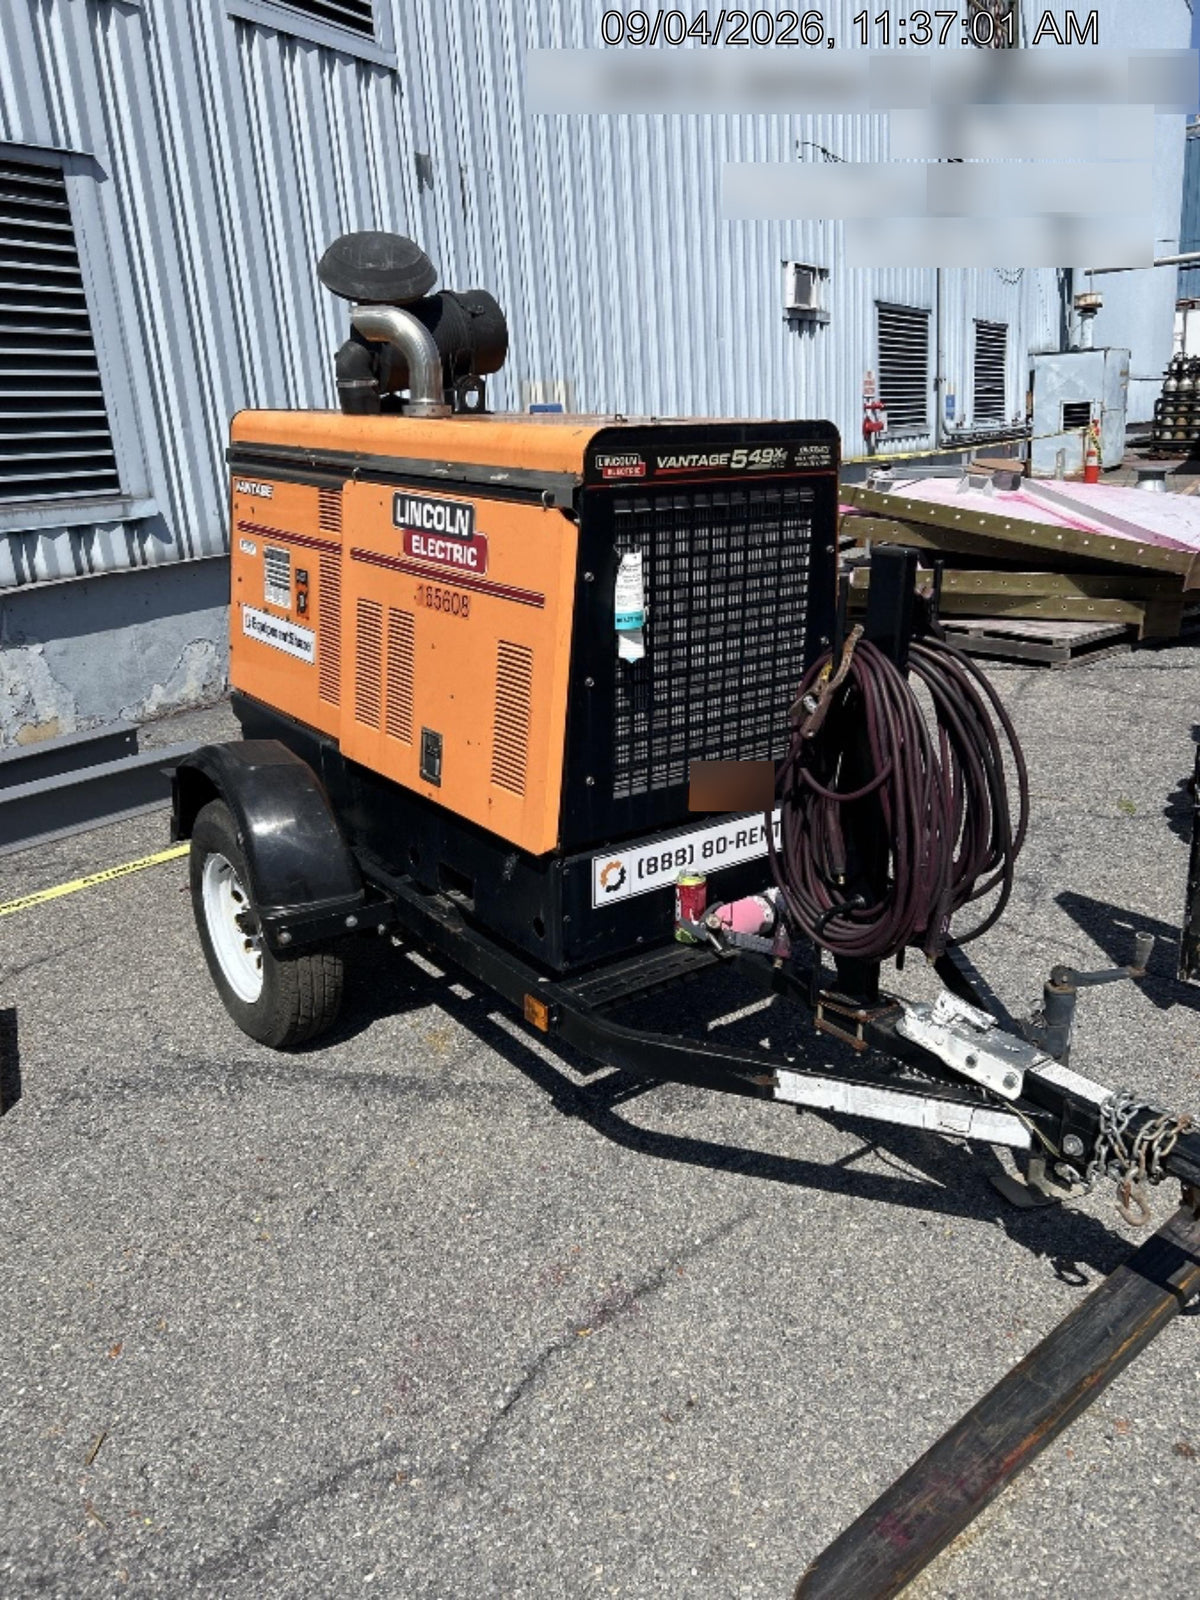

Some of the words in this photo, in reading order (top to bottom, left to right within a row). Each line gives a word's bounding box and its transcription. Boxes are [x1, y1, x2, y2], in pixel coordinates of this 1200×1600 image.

[657, 453, 731, 468] VANTAGE
[396, 499, 470, 536] LINCOLN
[411, 534, 478, 567] ELECTRIC
[415, 584, 470, 618] 165608
[637, 846, 695, 879] (888)
